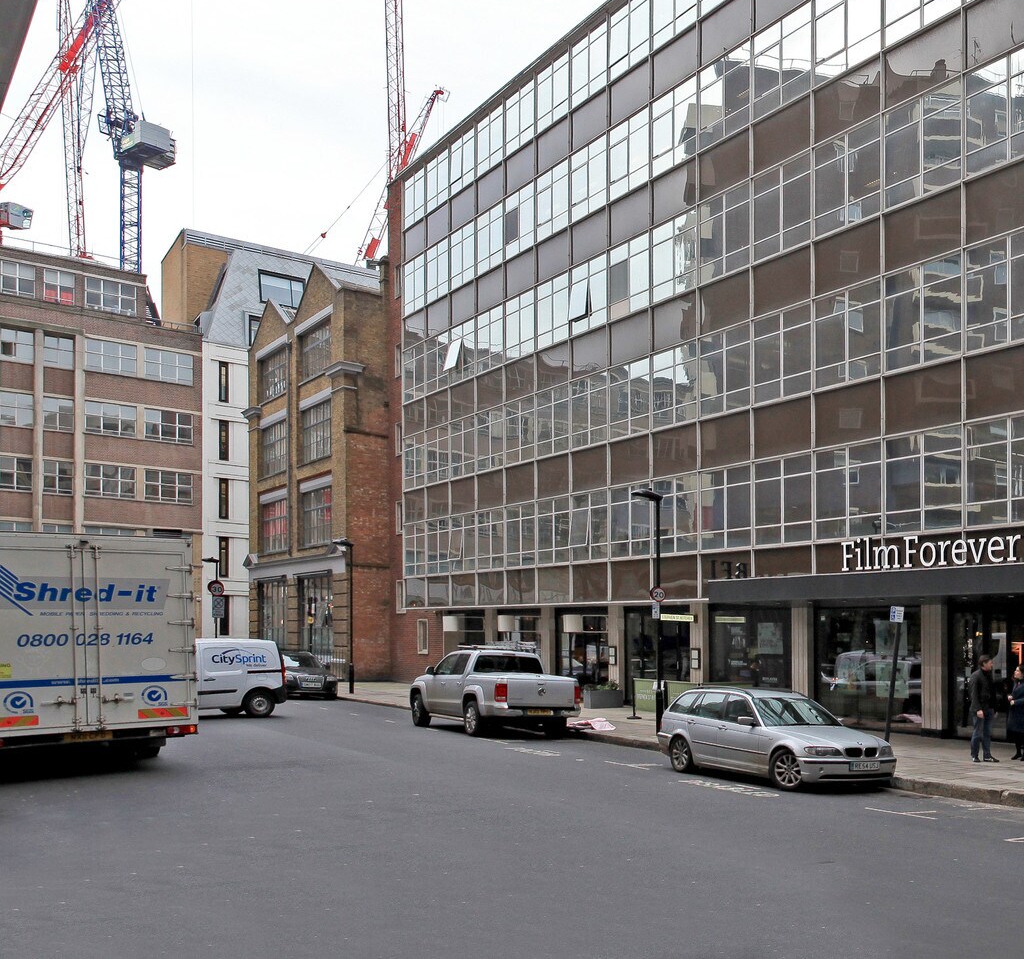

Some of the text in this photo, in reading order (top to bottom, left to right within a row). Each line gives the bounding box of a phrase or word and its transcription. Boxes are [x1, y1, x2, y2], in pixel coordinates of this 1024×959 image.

[14, 582, 157, 602] Shred-it
[17, 632, 154, 647] 0800 028 1164
[211, 653, 267, 665] CitySprint
